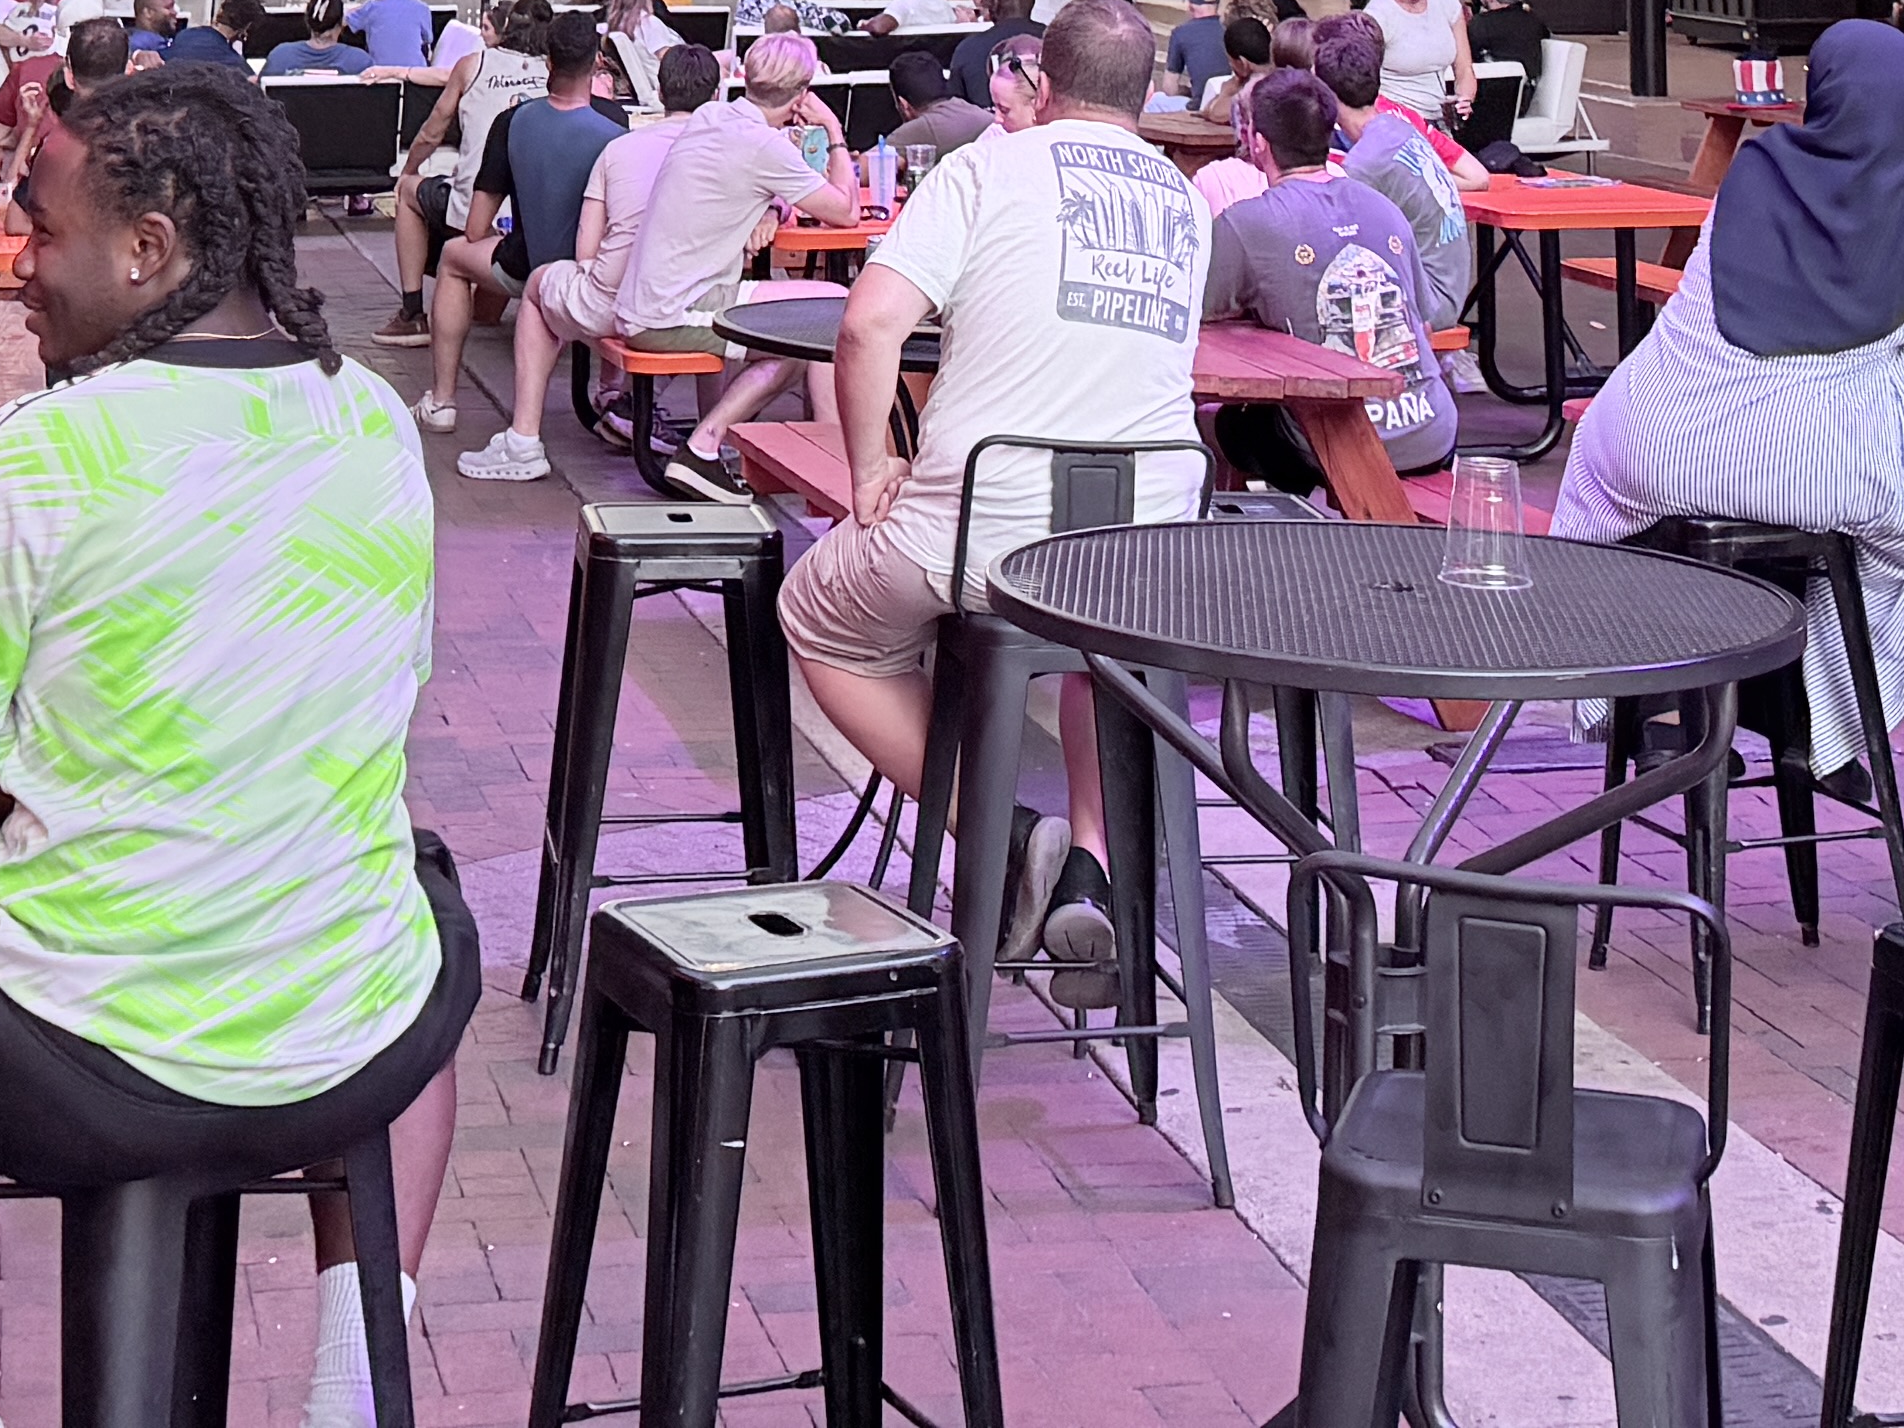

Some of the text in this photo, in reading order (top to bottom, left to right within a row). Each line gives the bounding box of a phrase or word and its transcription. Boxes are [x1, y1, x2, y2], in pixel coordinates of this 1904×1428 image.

[1056, 144, 1183, 191] NORTH SHORE
[1141, 259, 1176, 301] Life
[1066, 292, 1087, 308] EST.
[1090, 289, 1173, 332] PIPELINE
